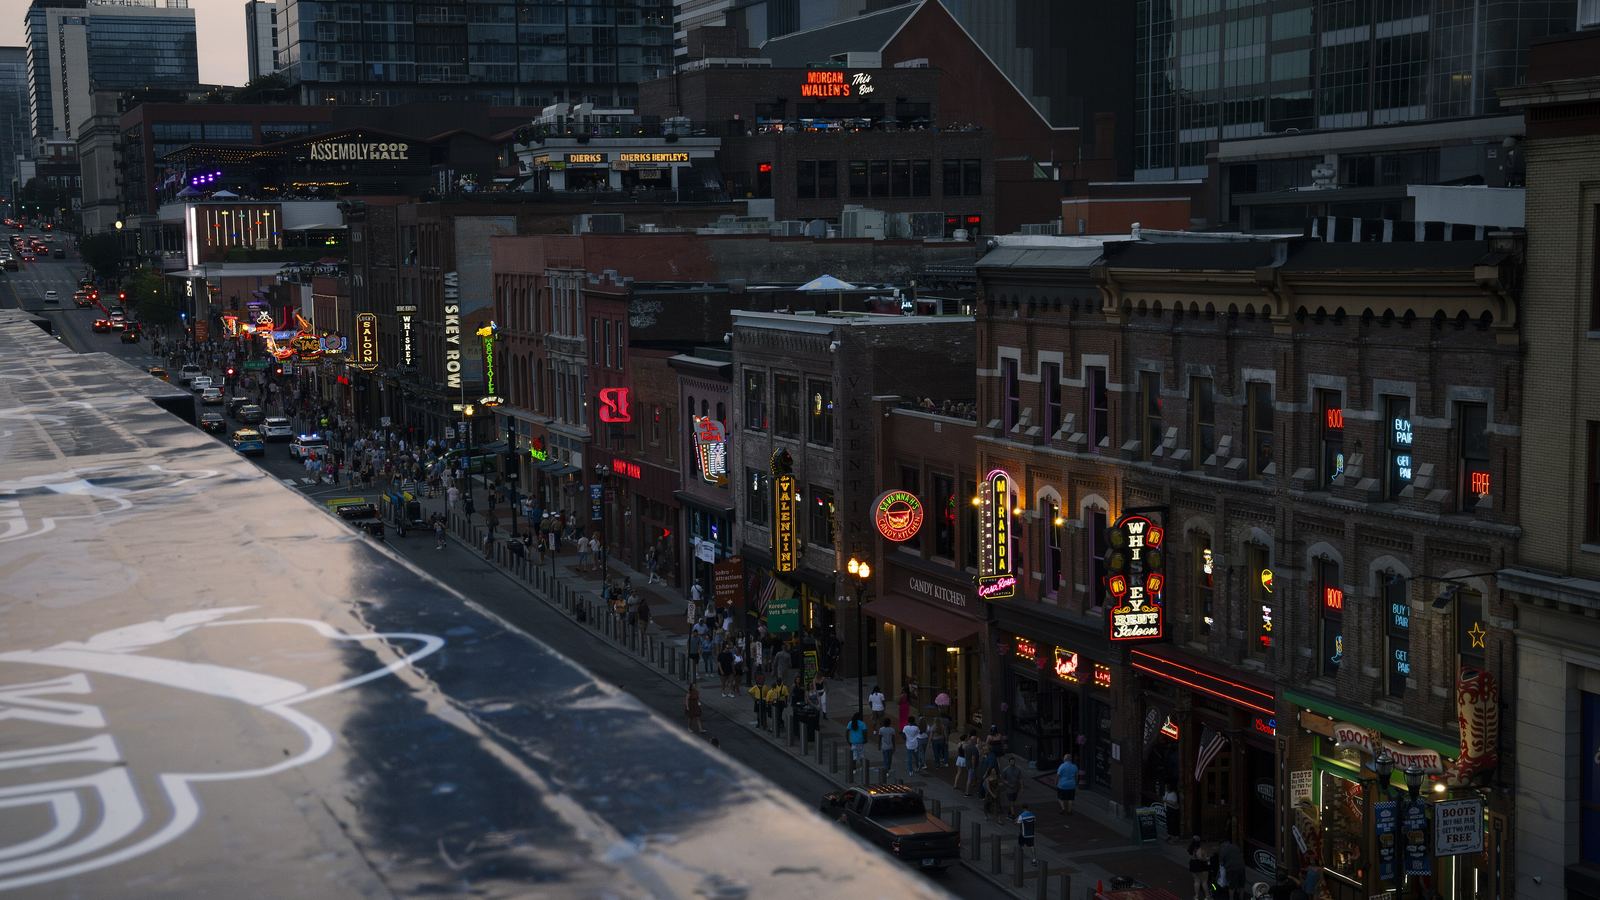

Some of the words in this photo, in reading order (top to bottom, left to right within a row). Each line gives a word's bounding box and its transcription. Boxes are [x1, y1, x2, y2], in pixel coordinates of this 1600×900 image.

[807, 71, 844, 84] MORGAN
[852, 72, 872, 85] This
[801, 84, 851, 97] WALLEN'S
[858, 84, 874, 96] Bar
[310, 143, 370, 160] ASSEMBLY
[370, 143, 408, 152] FOOD
[370, 152, 408, 160] HALL
[570, 154, 602, 163] DIERKS
[620, 153, 651, 162] DIERKS
[652, 153, 688, 162] BENTLEY'S
[444, 271, 461, 345] WHISKEY
[363, 321, 373, 363] SALOON
[402, 316, 412, 365] WHISKEY
[446, 349, 461, 389] ROW
[1395, 418, 1410, 432] BUY
[848, 376, 863, 553] VALENTINE
[1397, 456, 1409, 466] GET
[879, 492, 920, 512] SAVANNAH'S
[779, 482, 792, 572] VALENTINE
[878, 518, 897, 540] CANDY
[897, 516, 922, 540] KITCHEN
[996, 480, 1006, 570] MIRANDA
[1127, 522, 1145, 612] WHISKEY
[909, 576, 933, 596] CANDY
[934, 584, 966, 608] KITCHEN
[978, 584, 998, 596] Casa
[998, 578, 1016, 591] Rosa
[782, 608, 798, 616] Bridge
[1392, 603, 1406, 616] BUY
[1114, 614, 1158, 626] BENT
[1114, 626, 1158, 638] Saloon
[1395, 649, 1408, 662] GET
[1338, 729, 1370, 749] BOOT
[1442, 806, 1476, 818] BOOTS
[1446, 833, 1472, 843] FREE
